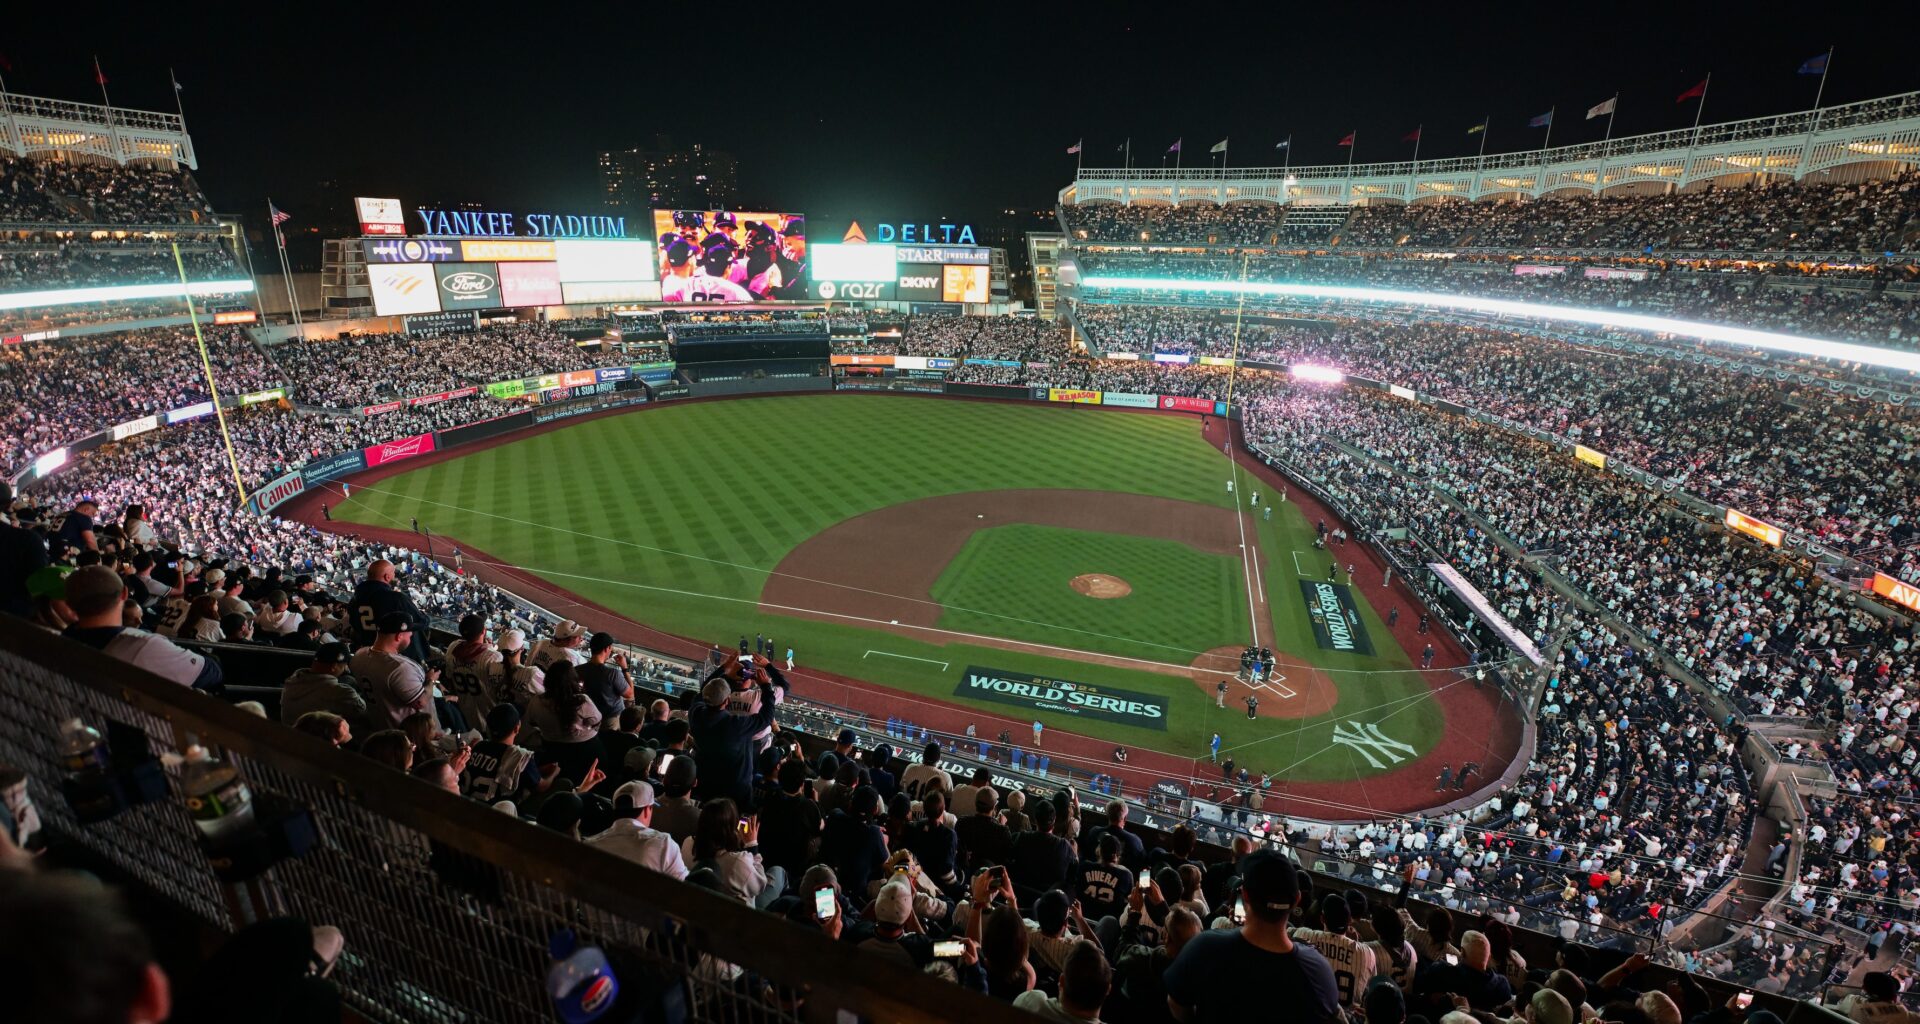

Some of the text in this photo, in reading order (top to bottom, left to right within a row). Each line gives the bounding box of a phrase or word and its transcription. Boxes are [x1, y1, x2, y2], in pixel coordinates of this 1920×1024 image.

[417, 210, 626, 238] YANKEE STADIUM
[879, 223, 977, 244] DELTA
[898, 249, 988, 262] STARR INSURANCE
[452, 275, 485, 291] Ford
[841, 283, 885, 298] razr
[900, 277, 940, 288] DKNY
[506, 385, 523, 394] Eats
[575, 387, 580, 397] A
[582, 385, 595, 396] SUB
[305, 463, 334, 479] Montefiore
[335, 455, 360, 468] Einstein
[258, 474, 303, 511] Canon
[359, 605, 377, 631] 2
[1315, 583, 1354, 649] WORLD SERIES
[453, 672, 481, 696] 99
[1033, 677, 1097, 693] 20 24
[970, 674, 1162, 718] WORLD SERIES
[470, 752, 498, 772] SOTO
[1085, 870, 1119, 889] RIVERA
[1318, 941, 1354, 965] UDGE
